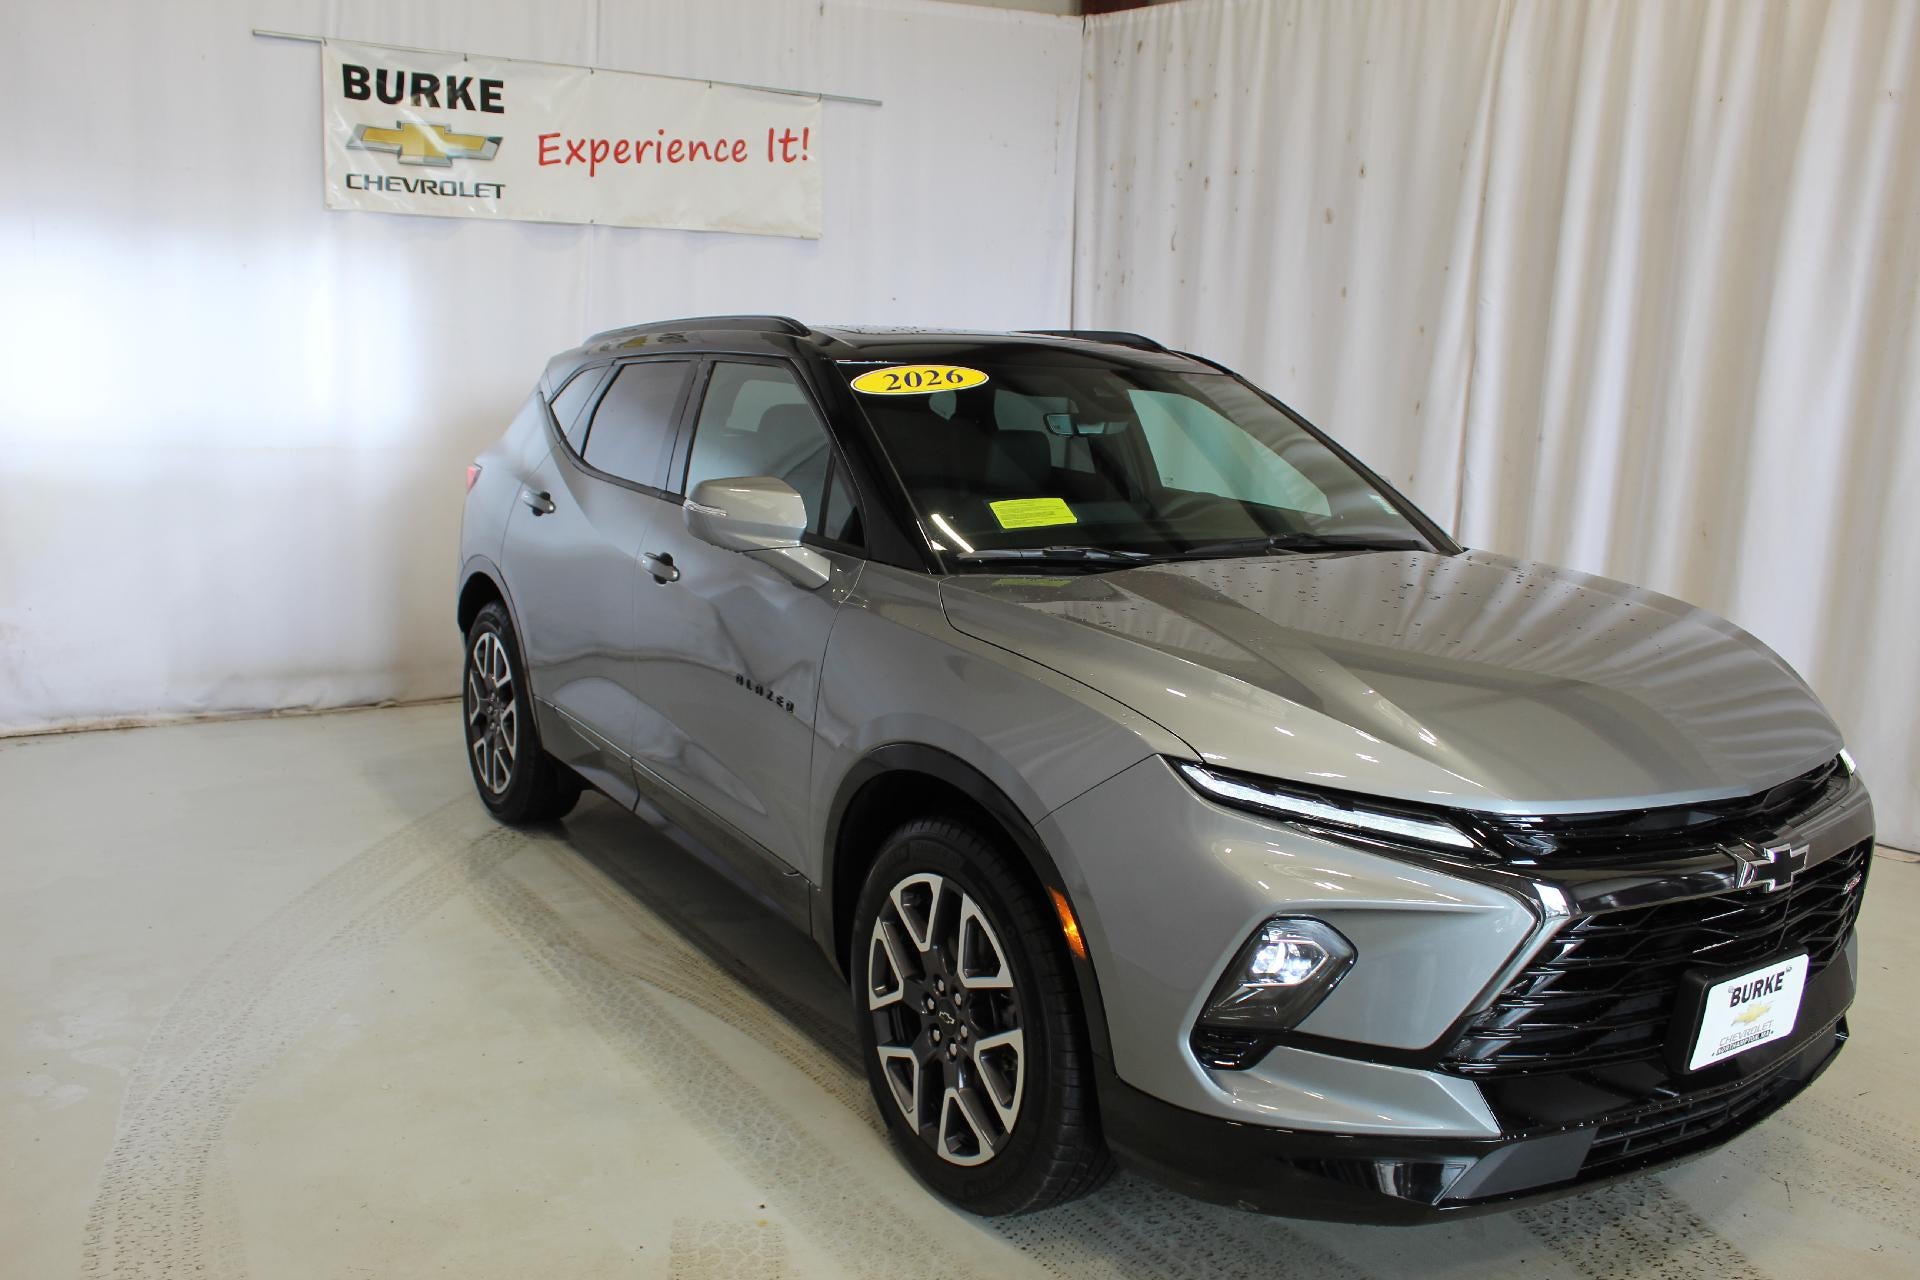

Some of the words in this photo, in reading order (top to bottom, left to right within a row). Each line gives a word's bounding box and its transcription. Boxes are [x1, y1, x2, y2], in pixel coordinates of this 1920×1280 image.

[342, 63, 505, 114] BURKE
[538, 129, 747, 177] Experience
[766, 127, 810, 163] It!
[345, 173, 507, 199] CHEVROLET
[882, 369, 964, 391] 2026
[735, 673, 795, 713] BLAZER
[1730, 971, 1785, 1008] BURKE
[1719, 1019, 1774, 1047] CHEVROLET
